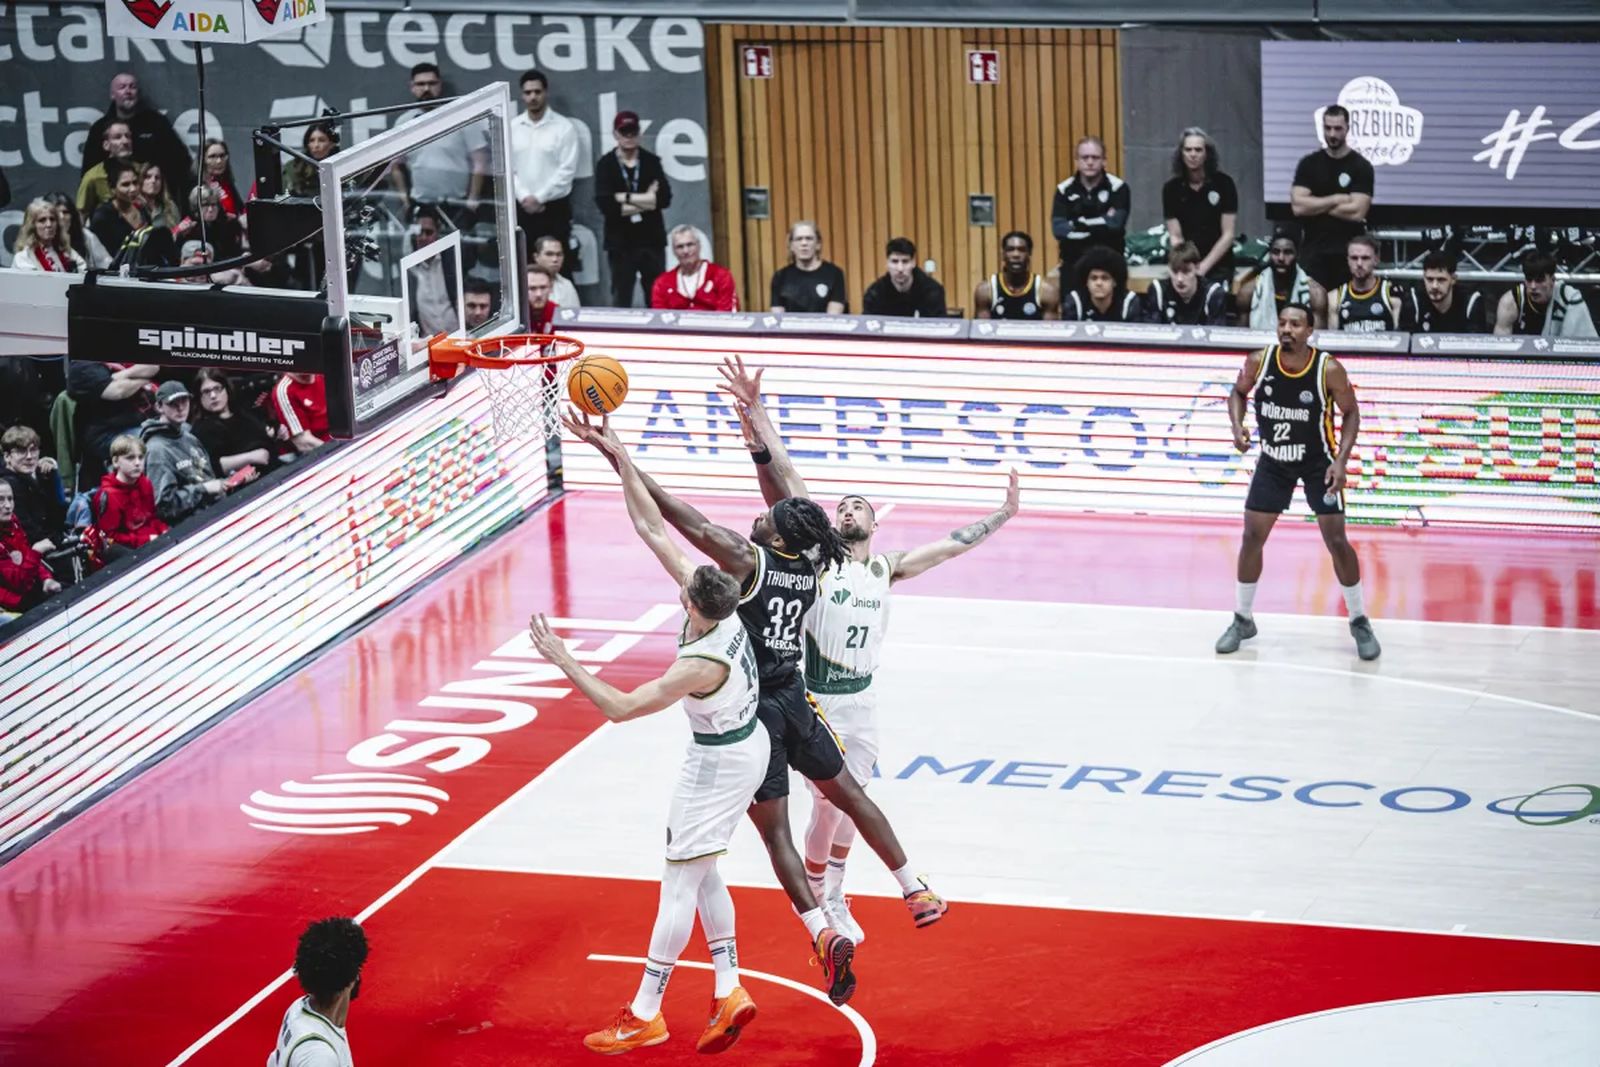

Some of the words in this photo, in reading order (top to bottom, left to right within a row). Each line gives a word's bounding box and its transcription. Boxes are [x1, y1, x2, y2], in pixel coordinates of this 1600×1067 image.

[172, 11, 230, 34] AIDA
[282, 0, 317, 22] AIDA
[343, 11, 705, 74] tectake
[1351, 109, 1415, 138] RZBURG
[138, 326, 305, 356] spindler
[171, 351, 221, 361] WILLKOMMEN
[222, 354, 241, 362] BEIM
[242, 356, 272, 365] BESTEN
[273, 358, 294, 366] TEAM
[1261, 401, 1310, 422] WÜRZBURG
[1273, 422, 1291, 442] 22
[767, 570, 815, 591] THOMPSON
[852, 596, 881, 612] Unicaja
[763, 597, 803, 640] 32
[846, 625, 869, 649] 27
[868, 754, 1472, 814] MERESCO
